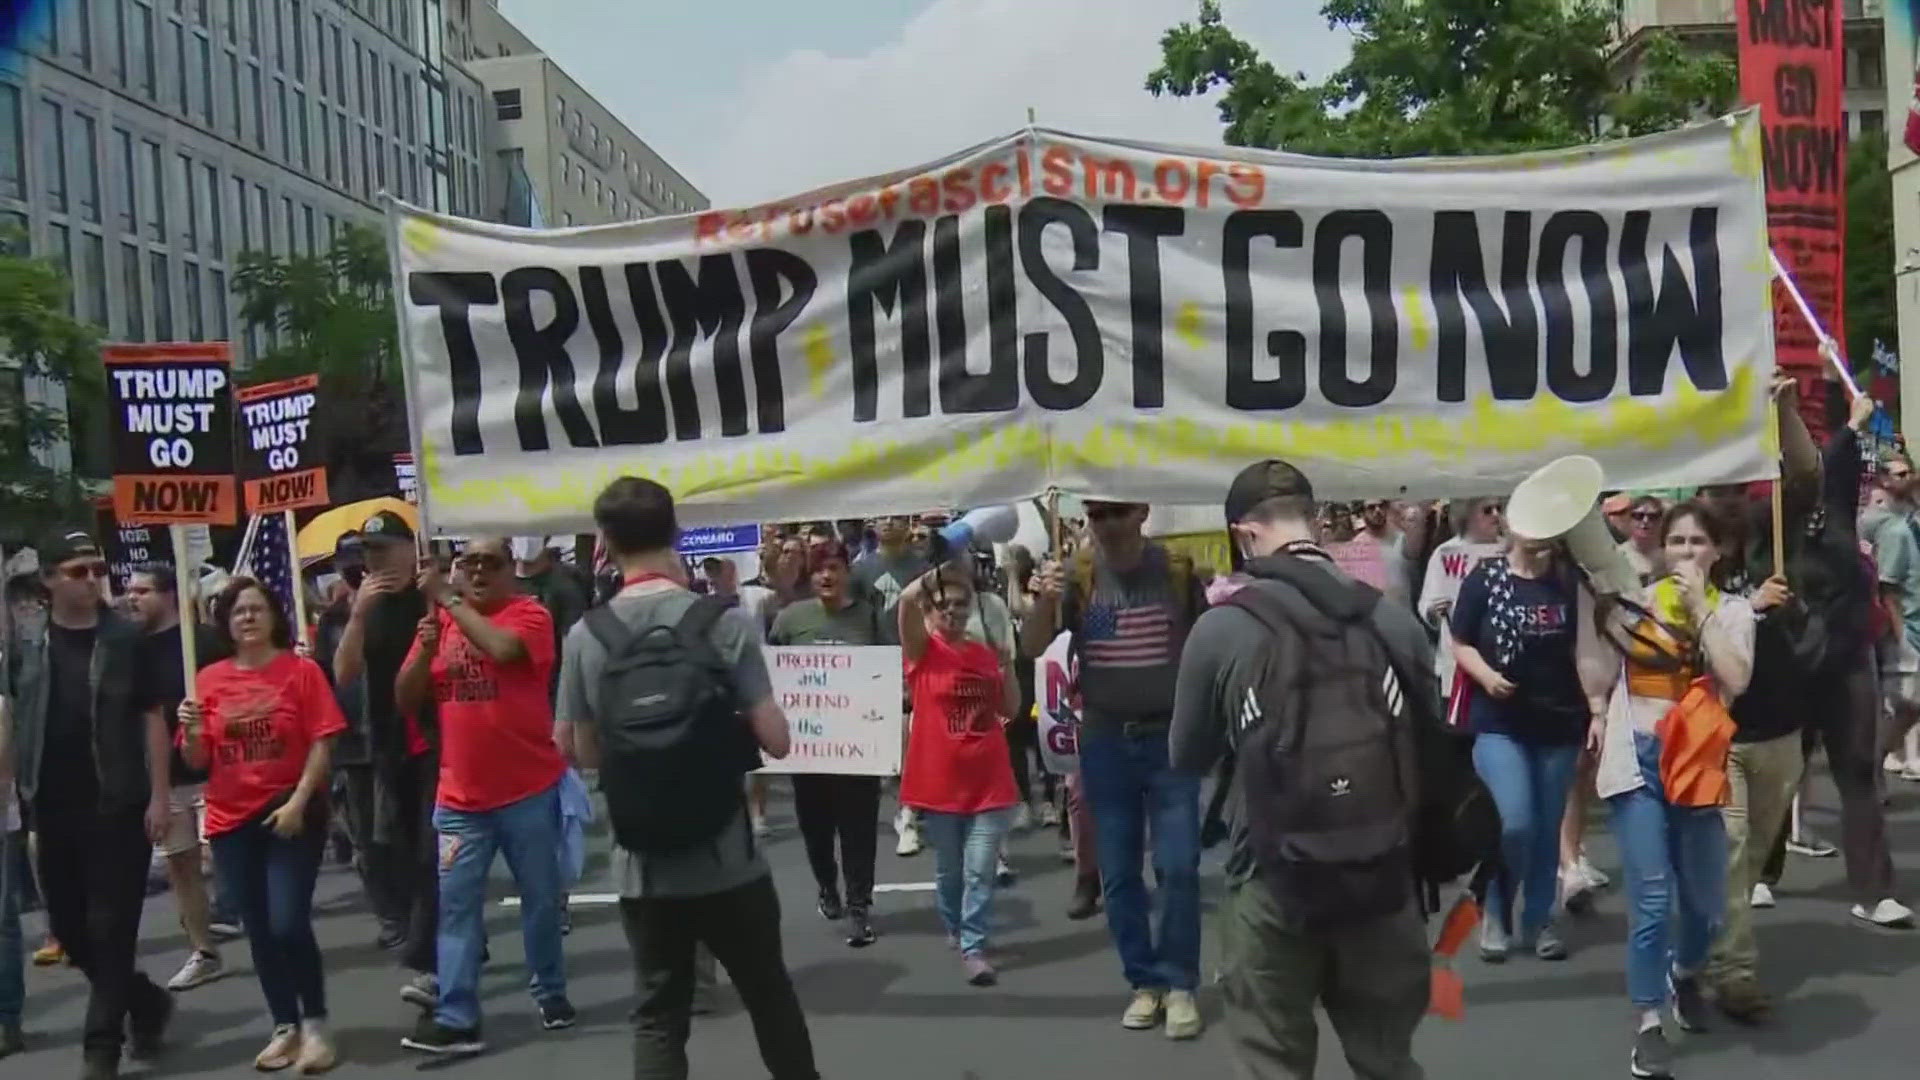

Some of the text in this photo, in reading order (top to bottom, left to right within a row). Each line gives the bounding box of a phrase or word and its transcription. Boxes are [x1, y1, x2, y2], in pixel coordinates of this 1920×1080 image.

[1747, 0, 1834, 48] MUST
[1775, 63, 1816, 118] GO
[408, 194, 1728, 455] TRUMP MUST GO NOW
[113, 369, 226, 399] TRUMP
[127, 404, 215, 433] MUST
[242, 393, 316, 427] TRUMP
[252, 420, 310, 451] MUST
[150, 438, 194, 468] GO
[268, 447, 299, 470] GO
[134, 481, 220, 512] NOW!
[258, 473, 315, 504] NOW!
